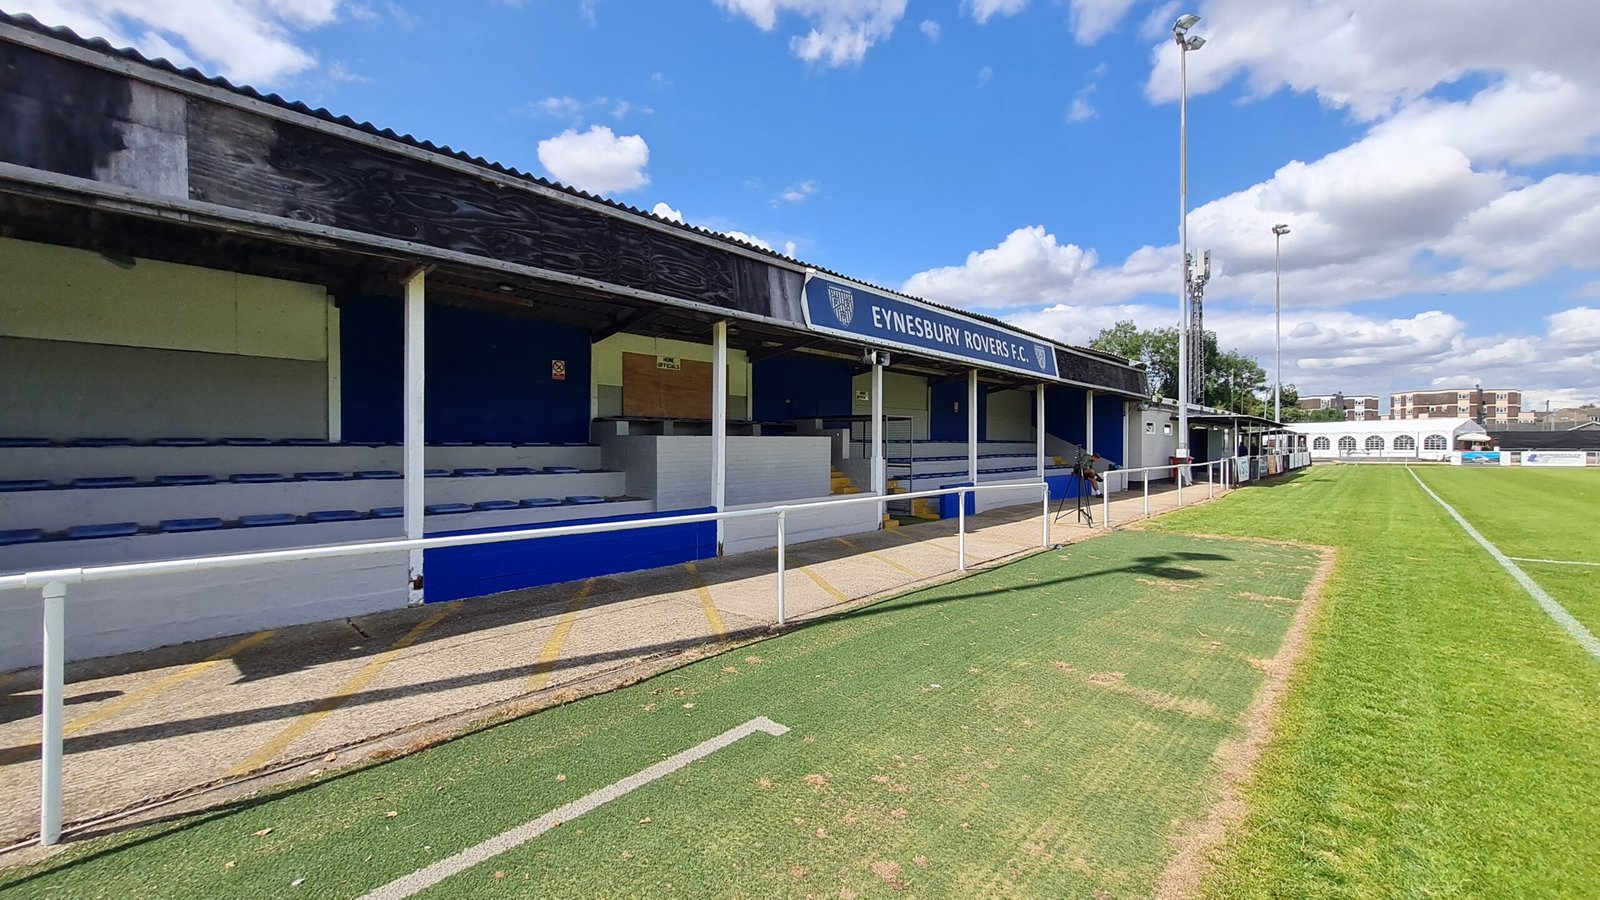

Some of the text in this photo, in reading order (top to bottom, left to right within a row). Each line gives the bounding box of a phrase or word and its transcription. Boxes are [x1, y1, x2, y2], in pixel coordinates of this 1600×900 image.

[872, 305, 1029, 363] EYNESBURY ROVERS F.C.
